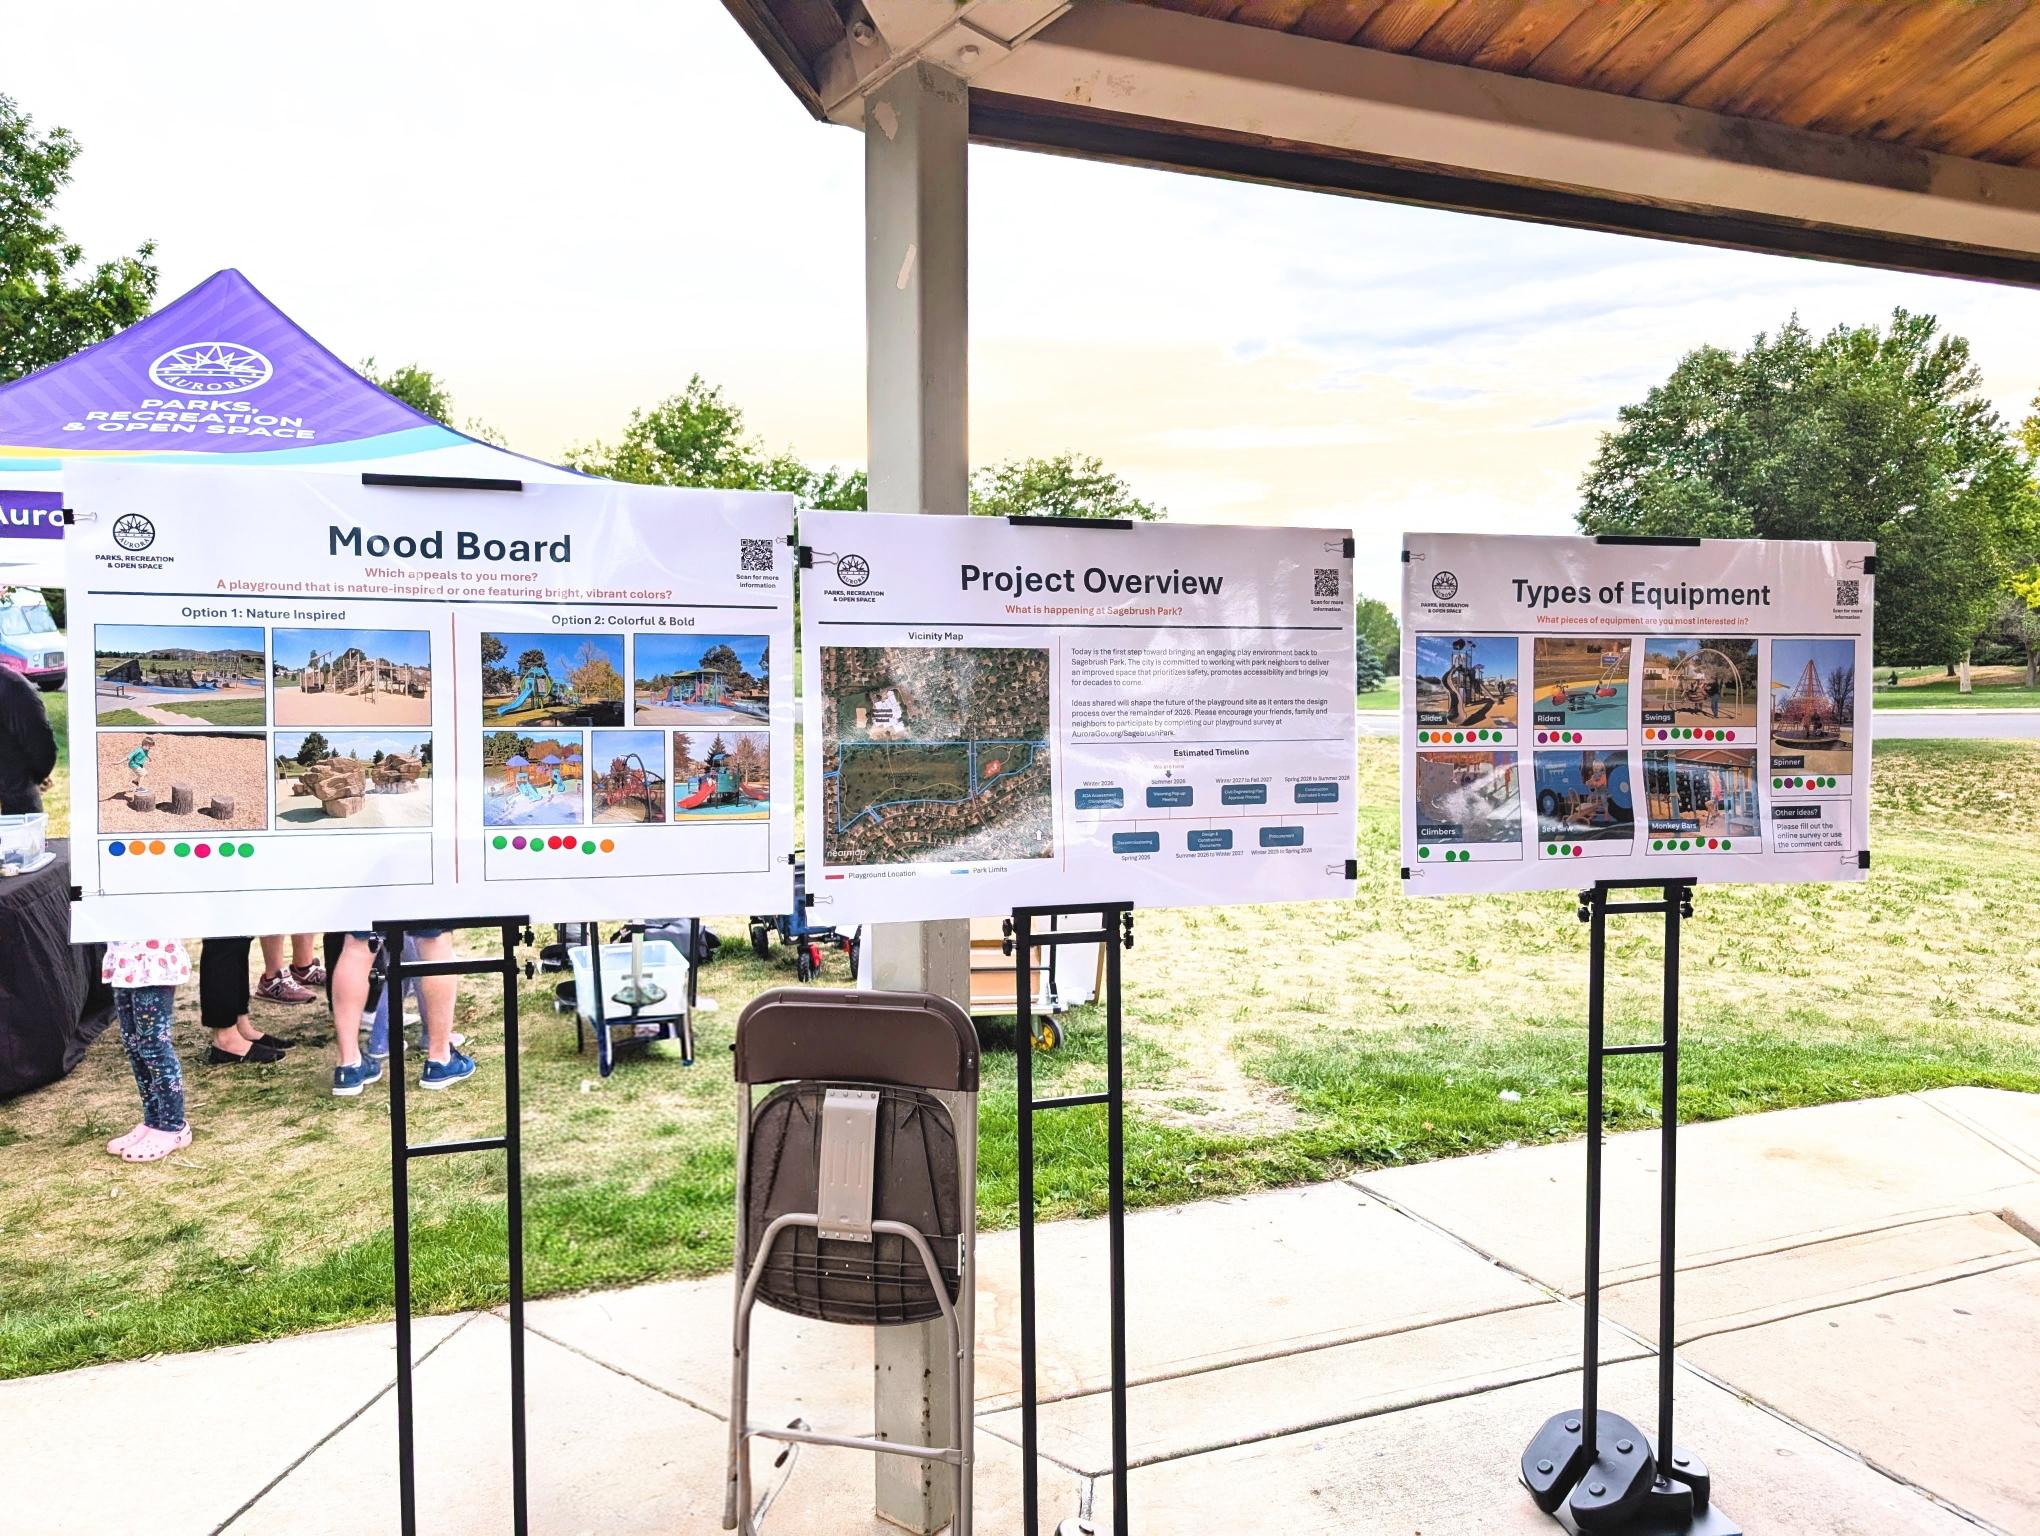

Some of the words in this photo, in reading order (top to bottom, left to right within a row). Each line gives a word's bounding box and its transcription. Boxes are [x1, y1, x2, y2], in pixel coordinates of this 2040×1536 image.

[165, 376, 254, 391] AURORA
[141, 399, 260, 414] PARKS,
[86, 411, 303, 428] RECREATION
[62, 422, 86, 431] &
[97, 422, 195, 433] OPEN
[206, 425, 315, 440] SPACE
[119, 538, 150, 548] AURORA
[329, 525, 443, 559] Mood
[457, 531, 572, 563] Board
[365, 568, 405, 578] Which
[408, 570, 457, 581] appeals
[461, 572, 473, 580] to
[476, 572, 497, 582] you
[501, 573, 538, 582] more?
[961, 564, 1075, 598] Project
[1083, 567, 1223, 595] Overview
[217, 579, 226, 589] A
[229, 580, 302, 592] playground
[305, 582, 330, 592] that
[334, 583, 344, 592] is
[348, 583, 443, 595] nature-inspired
[447, 587, 460, 595] or
[488, 586, 542, 599] featuring
[545, 588, 583, 599] bright,
[586, 589, 627, 598] vibrant
[630, 590, 672, 599] colors?
[1512, 578, 1591, 608] Types
[1598, 581, 1624, 604] of
[1631, 581, 1771, 610] Equipment
[182, 607, 227, 619] Option
[231, 608, 242, 618] 1:
[247, 608, 290, 619] Nature
[294, 609, 346, 621] Inspired
[1005, 604, 1031, 613] What
[1033, 605, 1042, 613] is
[1044, 605, 1094, 617] happening
[1107, 607, 1155, 617] Sagebrush
[1157, 607, 1182, 616] Park?
[552, 615, 592, 626] Option
[594, 615, 605, 625] 2:
[608, 615, 656, 626] Colorful
[658, 616, 666, 626] &
[669, 616, 695, 626] Bold
[1537, 615, 1559, 624] What
[1561, 616, 1588, 625] pieces
[1590, 616, 1599, 624] of
[1600, 616, 1643, 625] equipment
[1659, 618, 1674, 626] you
[1675, 617, 1696, 625] most
[1697, 617, 1736, 625] interested
[1738, 617, 1749, 625] in?
[908, 631, 943, 642] Vicinity
[945, 632, 964, 642] Map
[1072, 648, 1091, 656] Today
[1128, 649, 1142, 657] step
[1237, 649, 1251, 657] play
[1131, 699, 1152, 707] shape
[1072, 710, 1099, 718] process
[1295, 708, 1314, 716] family
[1645, 714, 1671, 722] Swings
[1173, 749, 1214, 757] Estimated
[1215, 748, 1249, 756] Timeline
[1796, 808, 1818, 816] ideas?
[1421, 828, 1456, 836] Climbers
[1652, 822, 1680, 831] Monkey
[848, 871, 886, 880] Playground
